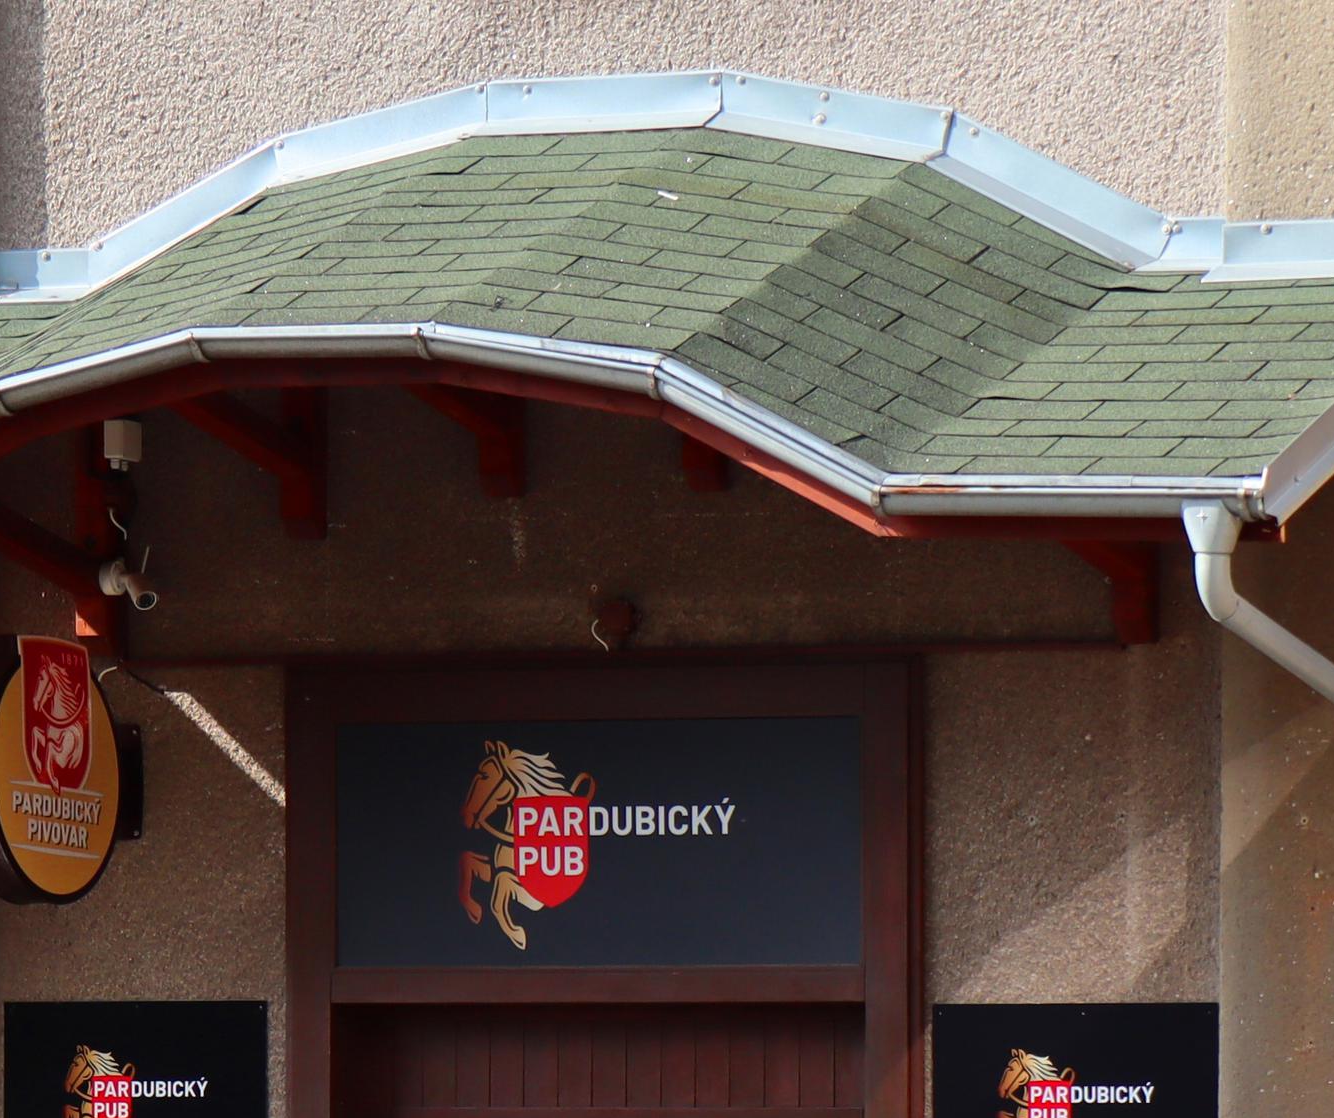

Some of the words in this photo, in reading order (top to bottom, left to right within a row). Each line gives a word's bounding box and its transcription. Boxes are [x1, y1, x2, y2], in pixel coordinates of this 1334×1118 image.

[11, 791, 102, 825] PARDUBICKÝ
[518, 797, 736, 836] PARDUBICKÝ
[26, 819, 89, 849] PIVOVAR
[518, 846, 584, 876] PUB
[93, 1076, 208, 1098] PARDUBICKÝ
[1029, 1081, 1155, 1104] PARDUBICKÝ
[93, 1102, 129, 1118] PUB
